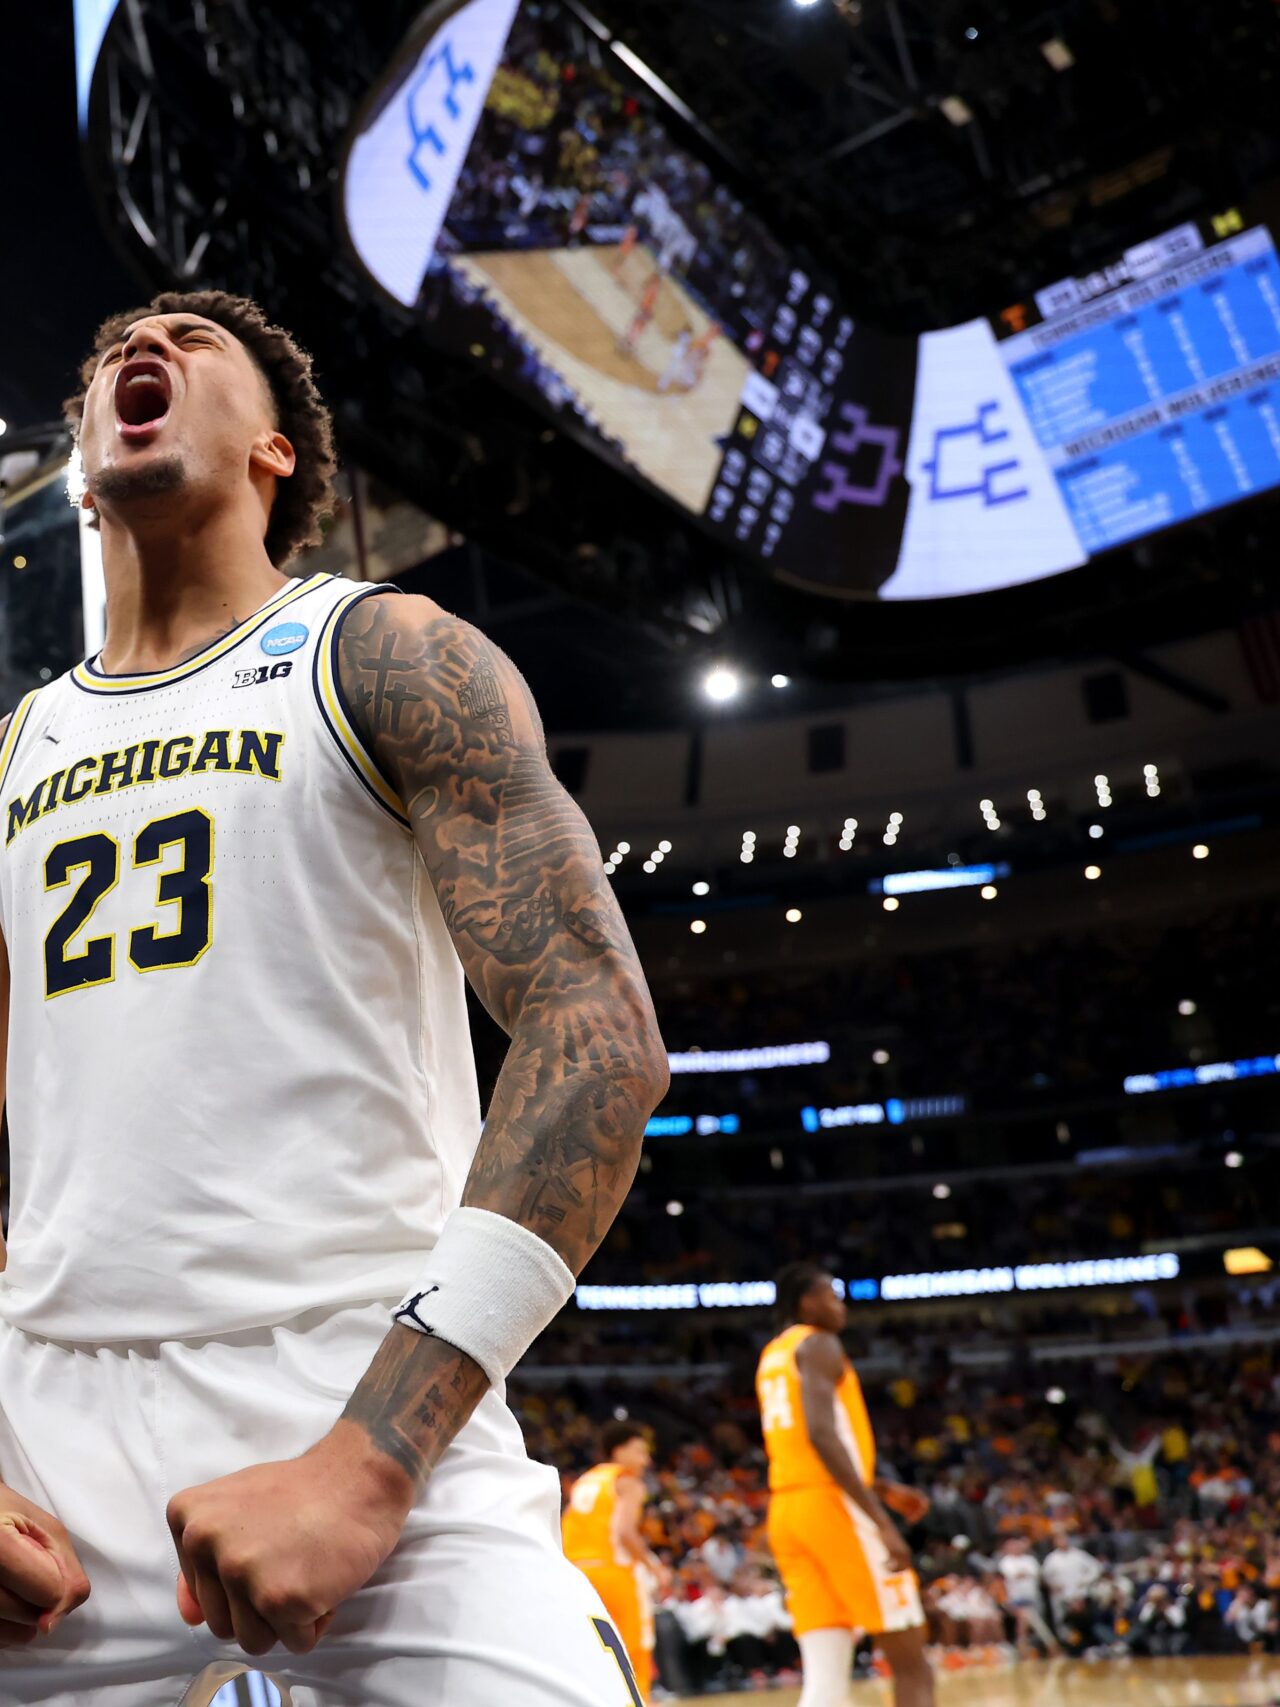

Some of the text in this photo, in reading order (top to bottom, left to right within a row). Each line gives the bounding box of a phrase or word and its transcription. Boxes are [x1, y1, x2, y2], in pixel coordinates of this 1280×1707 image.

[5, 728, 286, 848] MICHIGAN
[44, 804, 217, 1002] 23
[880, 1265, 1015, 1301] MICHIGAN
